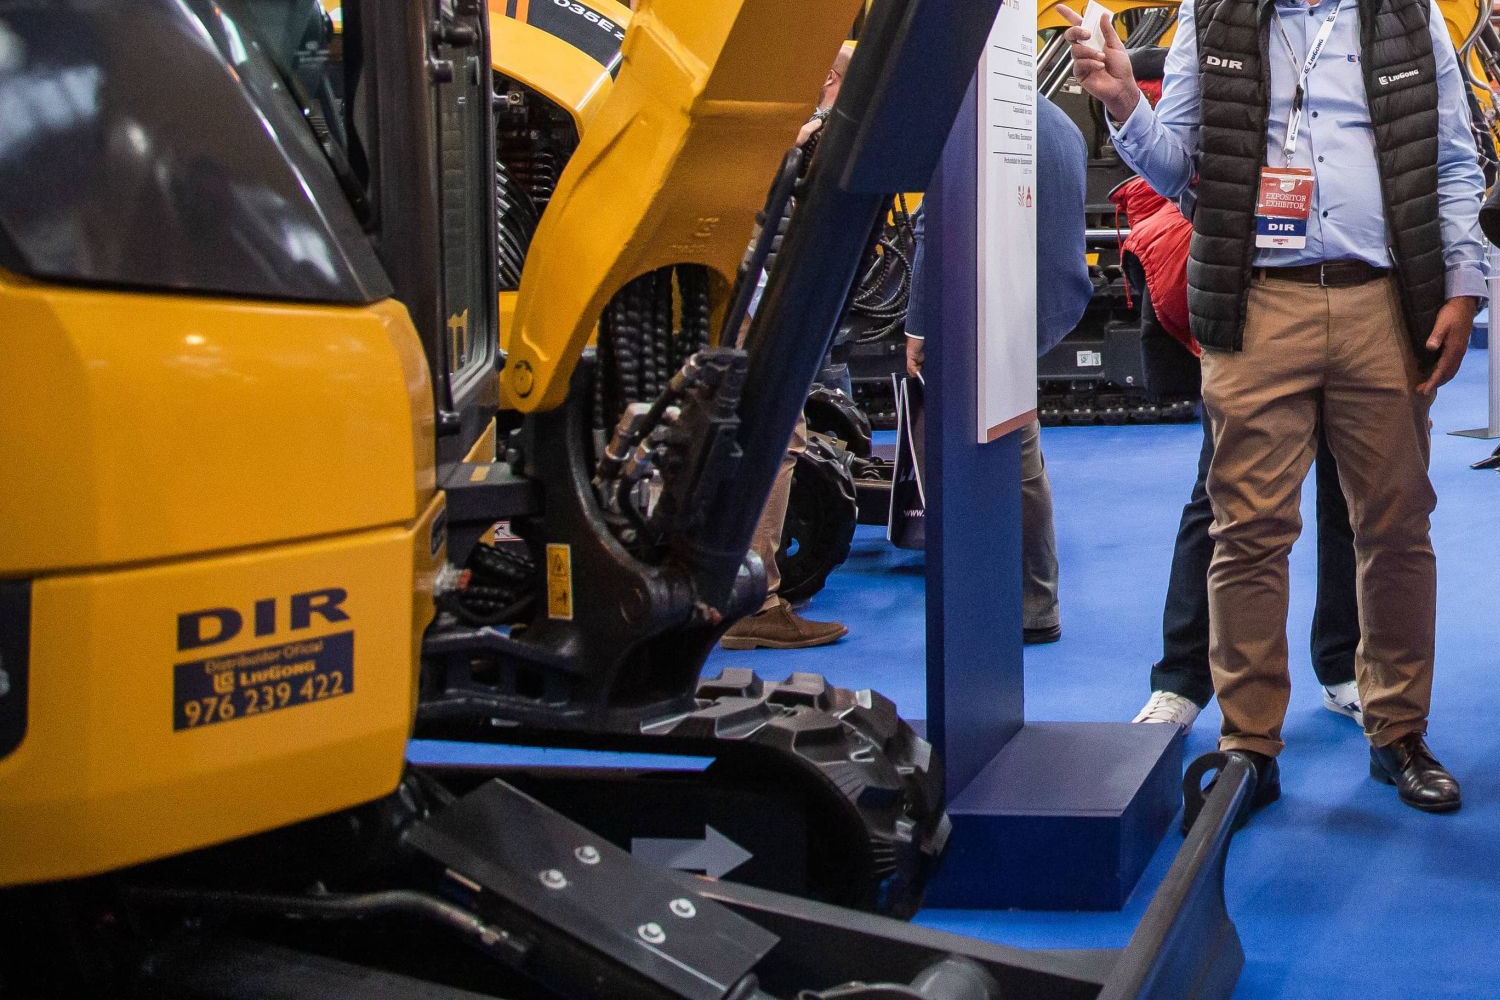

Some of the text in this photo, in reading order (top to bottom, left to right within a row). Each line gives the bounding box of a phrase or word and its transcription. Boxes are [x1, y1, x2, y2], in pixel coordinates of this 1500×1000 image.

[1206, 55, 1243, 70] DIR
[1388, 69, 1419, 82] LIUGONG
[1265, 192, 1307, 202] EXPOSITOR
[1265, 200, 1305, 210] EXHIBITOR
[1268, 223, 1295, 231] DIR
[177, 587, 350, 652] DIR
[184, 671, 344, 727] 976 239 422
